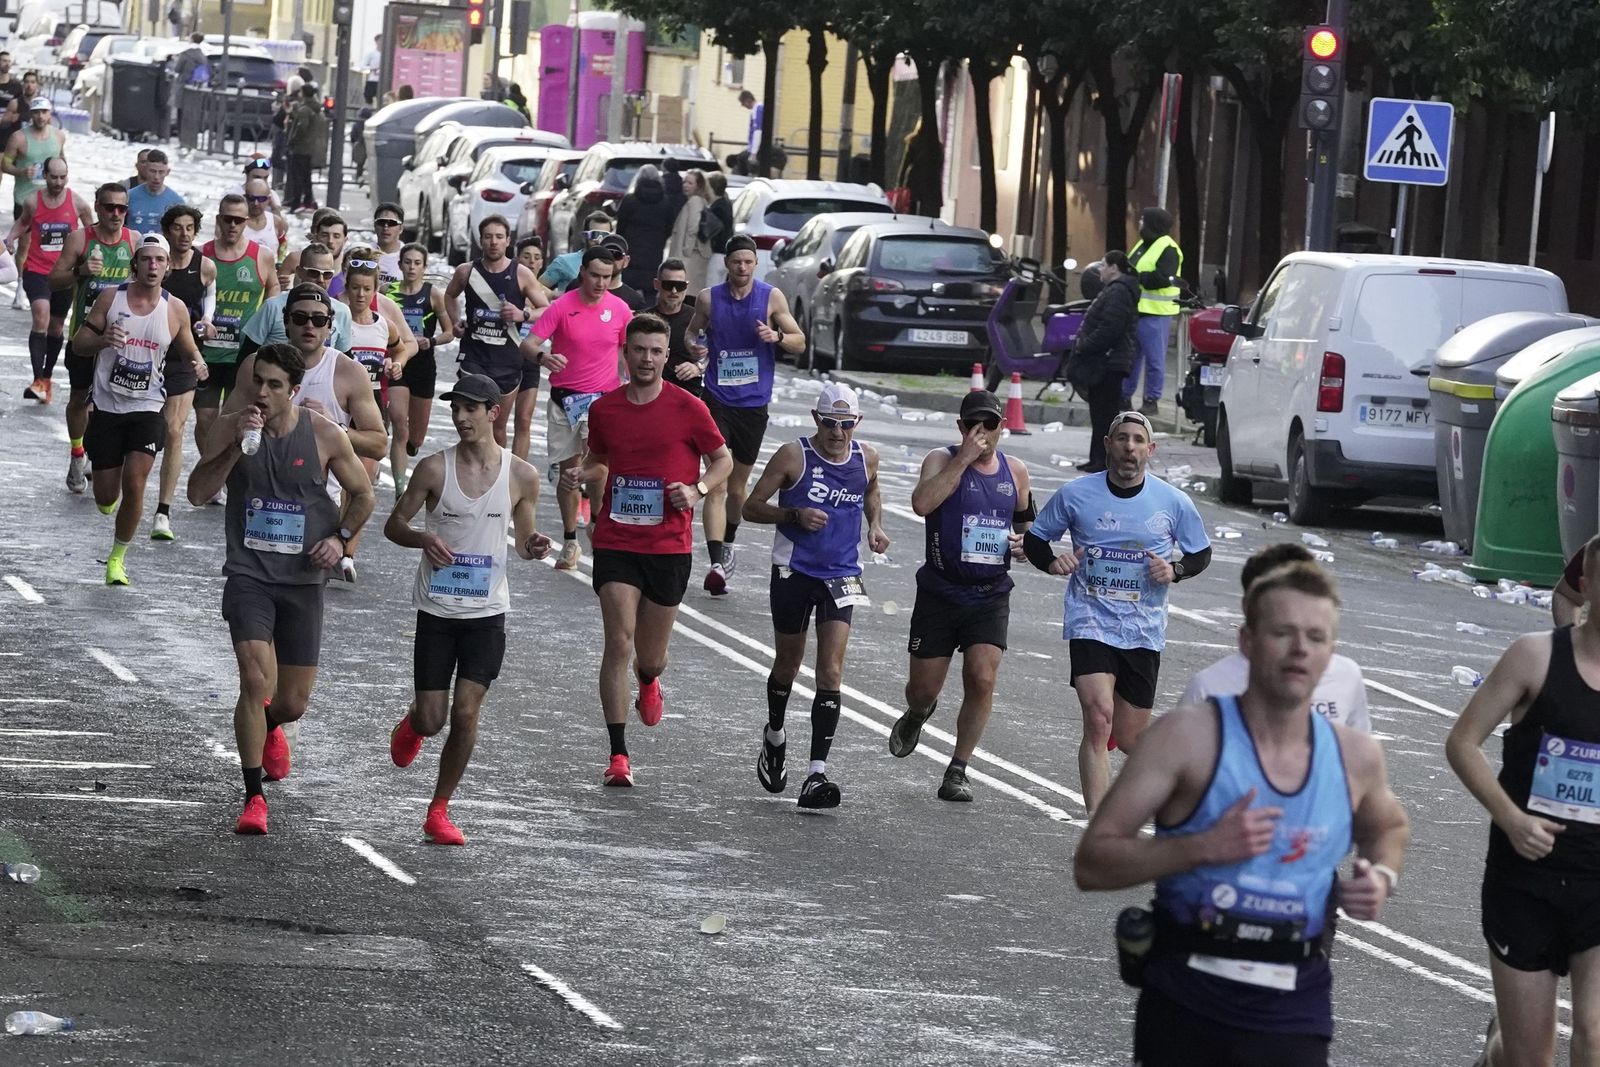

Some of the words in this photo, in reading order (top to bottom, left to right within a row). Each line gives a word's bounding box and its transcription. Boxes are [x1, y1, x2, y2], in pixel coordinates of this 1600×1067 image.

[223, 308, 244, 318] RUN
[475, 327, 503, 337] JOHNNY
[722, 368, 754, 377] THOMAS
[113, 374, 147, 390] CHARLES
[1368, 408, 1402, 422] 9177
[1406, 410, 1431, 424] MFY
[628, 480, 658, 488] ZURICH
[628, 493, 644, 501] 5903
[829, 488, 862, 507] Pfizer
[620, 502, 653, 513] HARRY
[980, 518, 1006, 527] ZURICH
[246, 529, 267, 539] PABLO
[267, 533, 304, 543] MARTINEZ
[975, 541, 999, 554] DINIS
[1105, 550, 1138, 561] ZURICH
[1104, 565, 1121, 574] 9481
[451, 571, 470, 580] 6896
[1109, 578, 1141, 589] ANGEL
[430, 584, 453, 594] TOMEU
[453, 587, 489, 597] FERRANDO
[1555, 783, 1596, 803] PAUL
[1241, 893, 1304, 914] ZURICH
